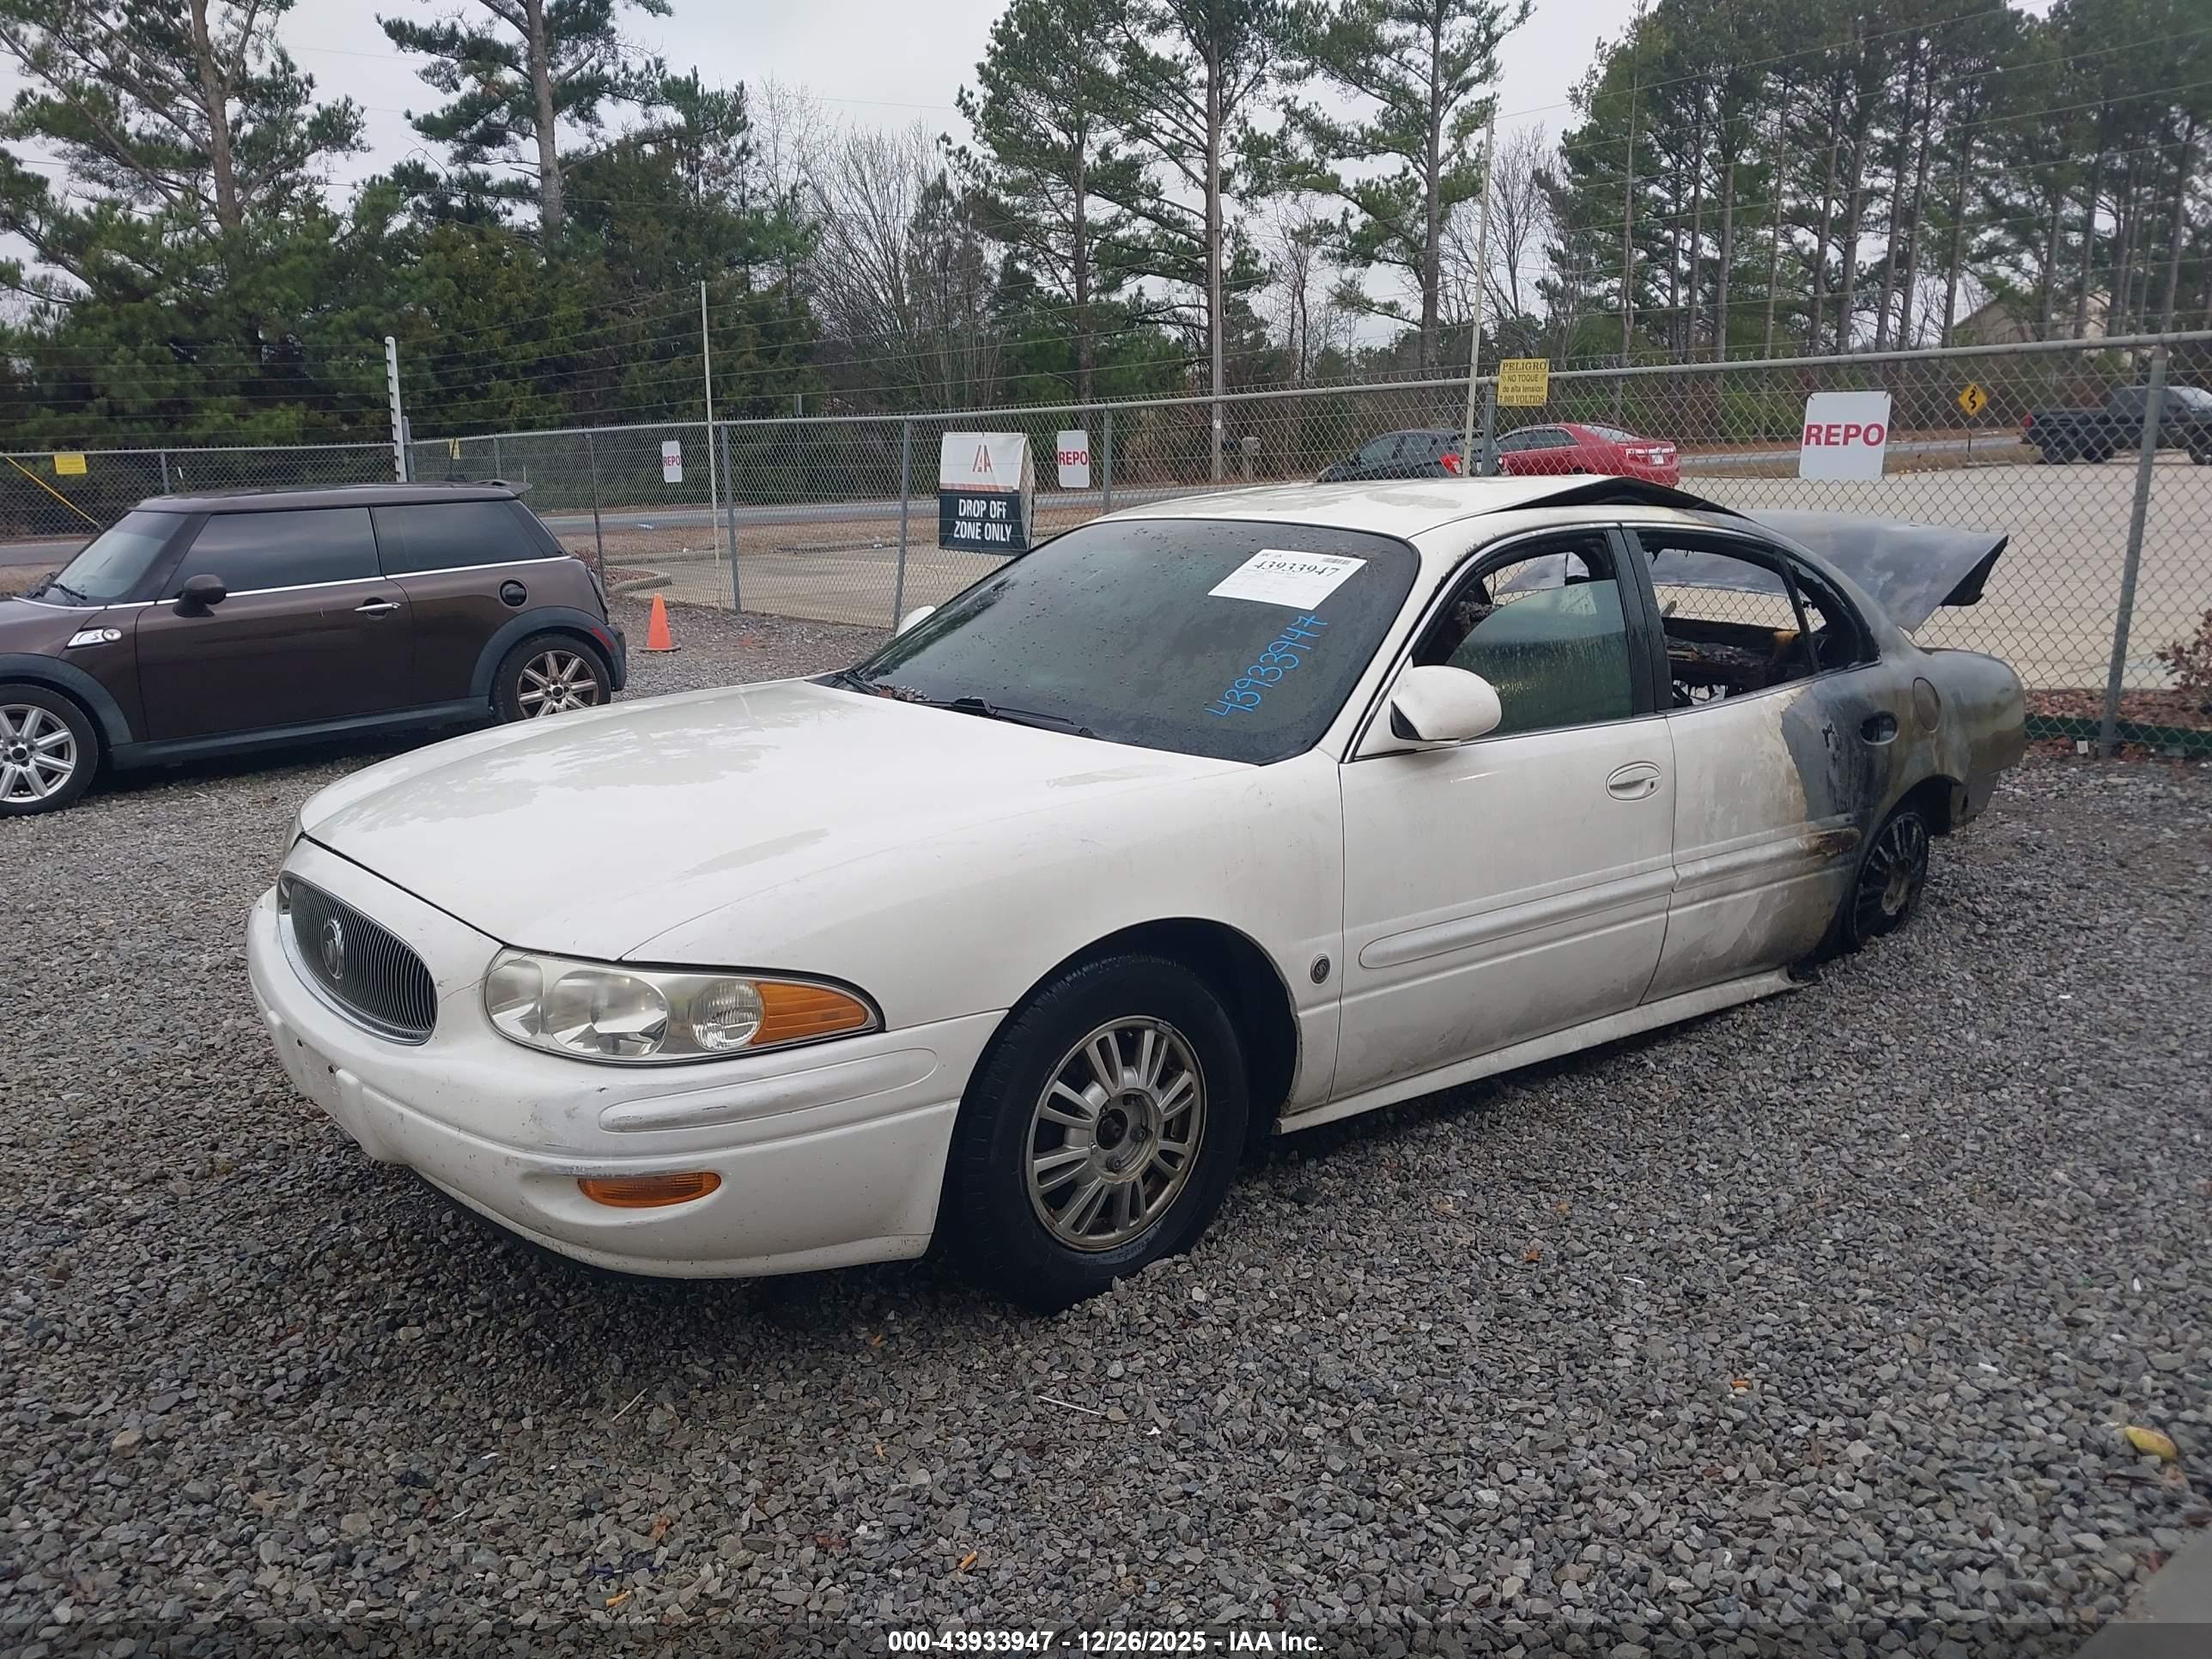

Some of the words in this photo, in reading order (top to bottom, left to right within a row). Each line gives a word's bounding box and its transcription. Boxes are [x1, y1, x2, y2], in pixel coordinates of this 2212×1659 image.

[1503, 362, 1547, 371] PELIGRO
[1507, 374, 1516, 383] NO
[1517, 374, 1540, 383] TOQUE
[1516, 395, 1546, 404] VOLTIOS
[1804, 423, 1886, 447] REPO
[663, 455, 681, 467] REPO
[1059, 451, 1088, 465] REPO
[958, 499, 987, 517] DROP
[989, 500, 1007, 519] OFF
[953, 520, 981, 539] ZONE
[984, 523, 1012, 542] ONLY
[1254, 560, 1340, 577] 43933947
[1204, 615, 1328, 715] 43933947
